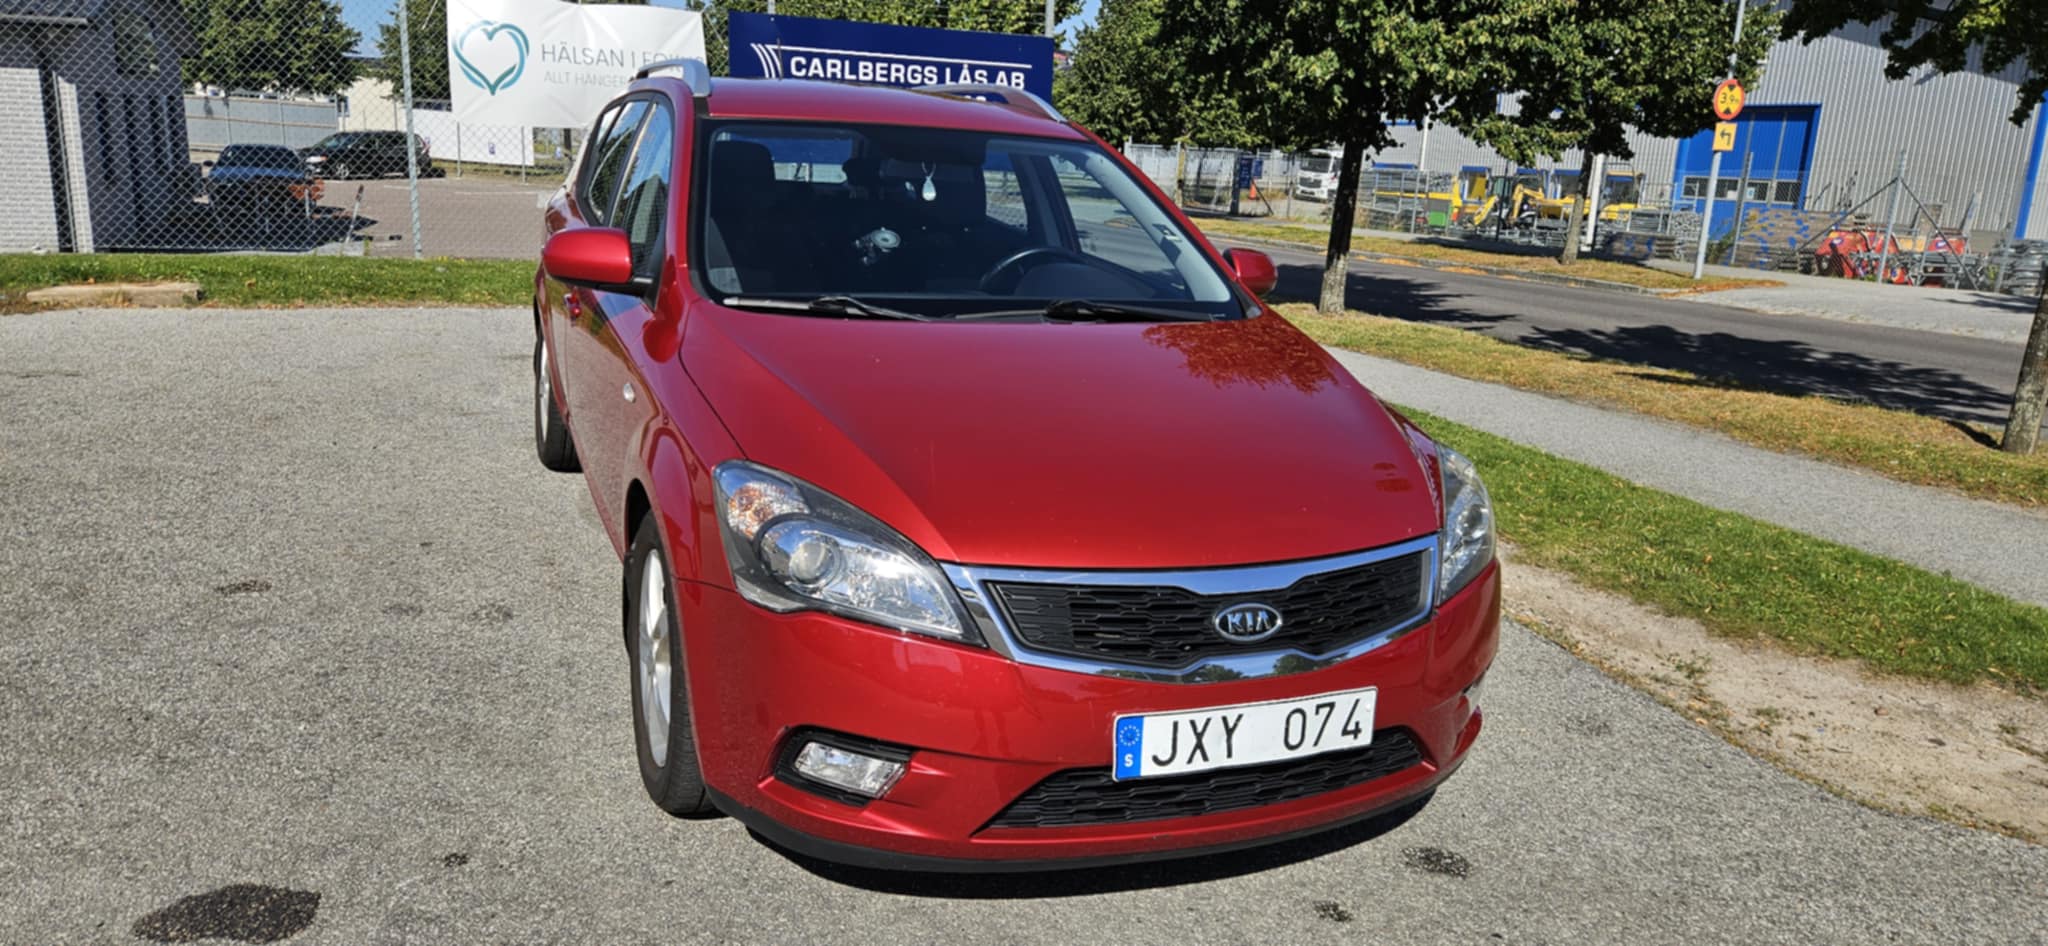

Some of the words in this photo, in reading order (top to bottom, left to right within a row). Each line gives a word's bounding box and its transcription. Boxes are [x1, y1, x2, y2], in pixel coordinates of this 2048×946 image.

[541, 41, 624, 68] HÄLSAN
[544, 71, 570, 84] ALLT
[790, 56, 938, 85] CARLBERGS
[945, 63, 988, 85] LÅS
[996, 71, 1025, 90] AB
[1226, 610, 1271, 633] KIA
[1152, 713, 1243, 767] JXY
[1283, 698, 1362, 751] 074
[1124, 753, 1134, 767] S
